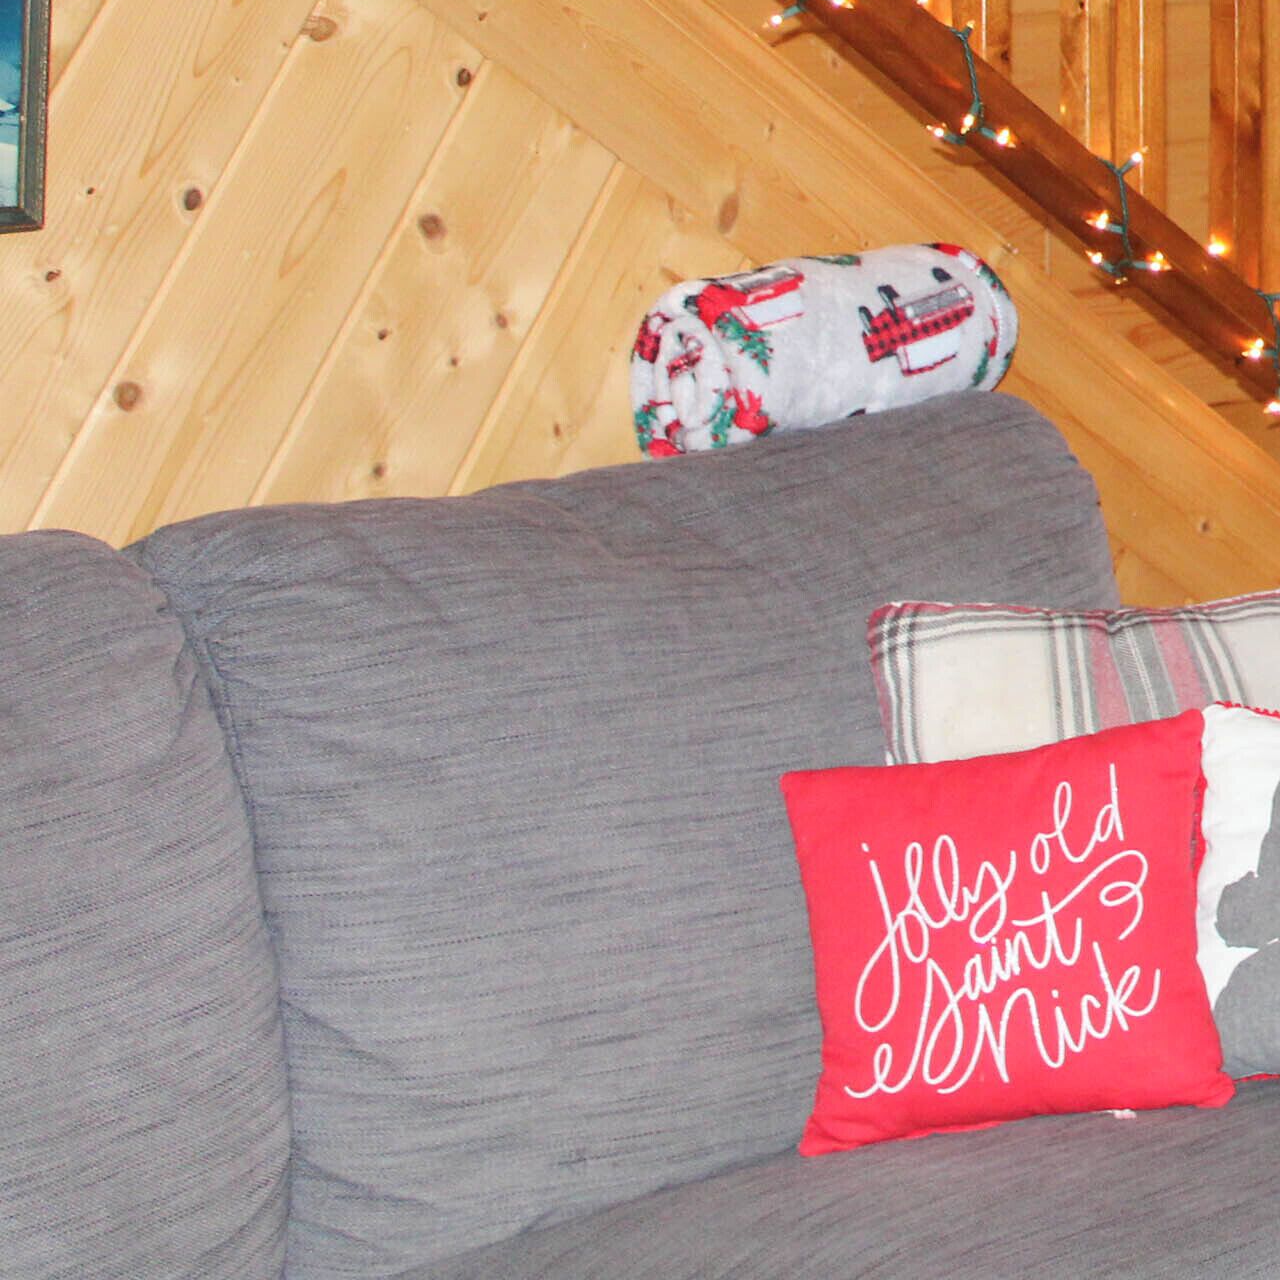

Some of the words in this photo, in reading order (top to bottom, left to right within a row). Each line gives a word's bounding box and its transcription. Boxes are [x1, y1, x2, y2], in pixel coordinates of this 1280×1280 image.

[855, 834, 1016, 1032] jolly
[1030, 763, 1125, 874] old
[937, 942, 1161, 1094] Nick
